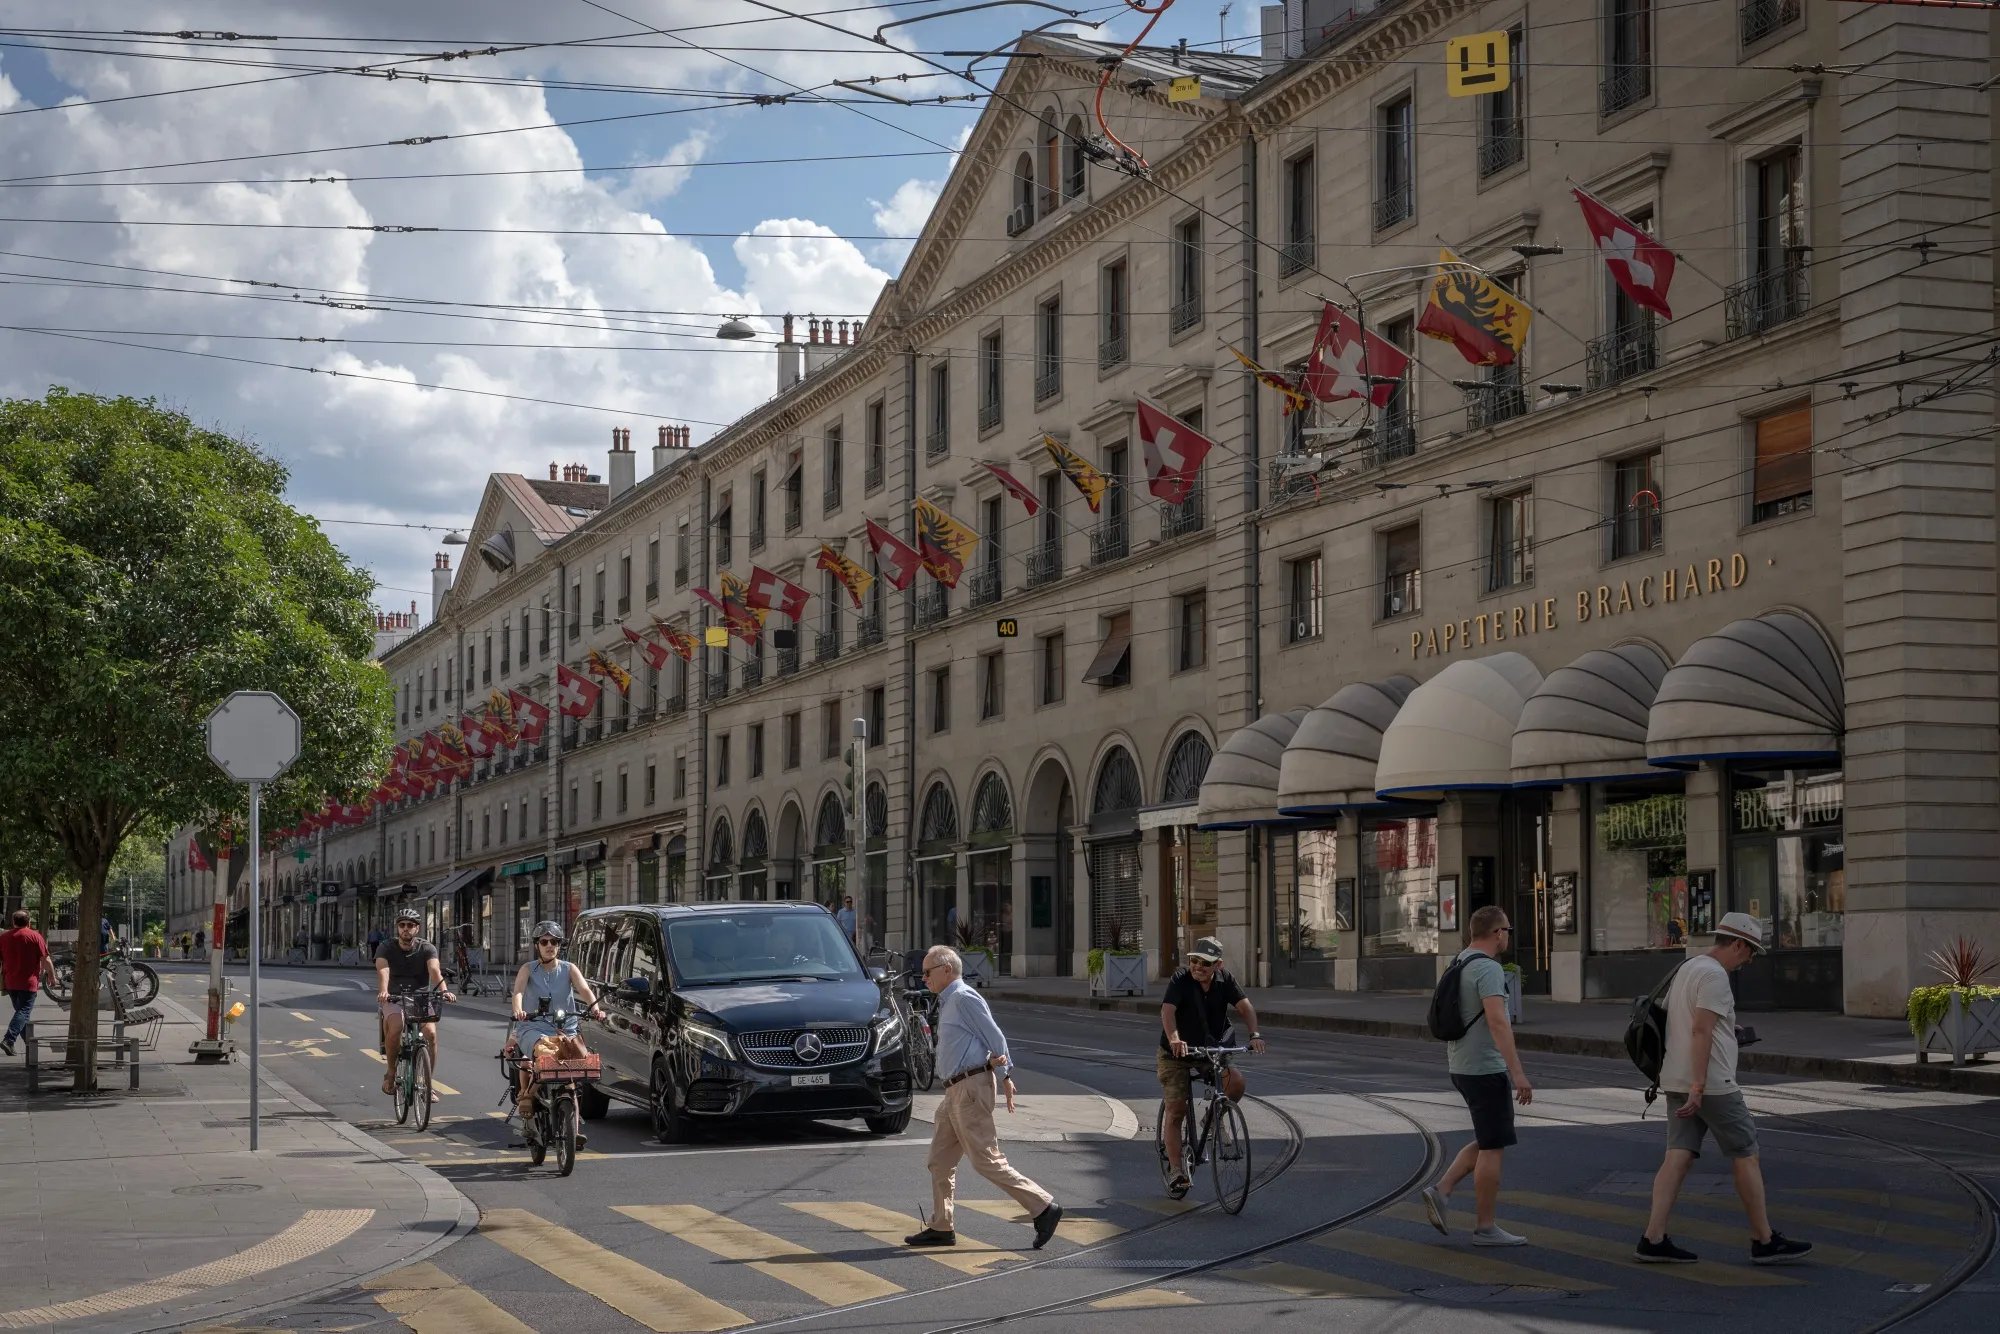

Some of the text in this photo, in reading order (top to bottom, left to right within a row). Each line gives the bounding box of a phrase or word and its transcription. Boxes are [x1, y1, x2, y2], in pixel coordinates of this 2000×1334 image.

[1000, 621, 1015, 635] 40
[1410, 552, 1748, 660] PAPETERIE BRACHARD
